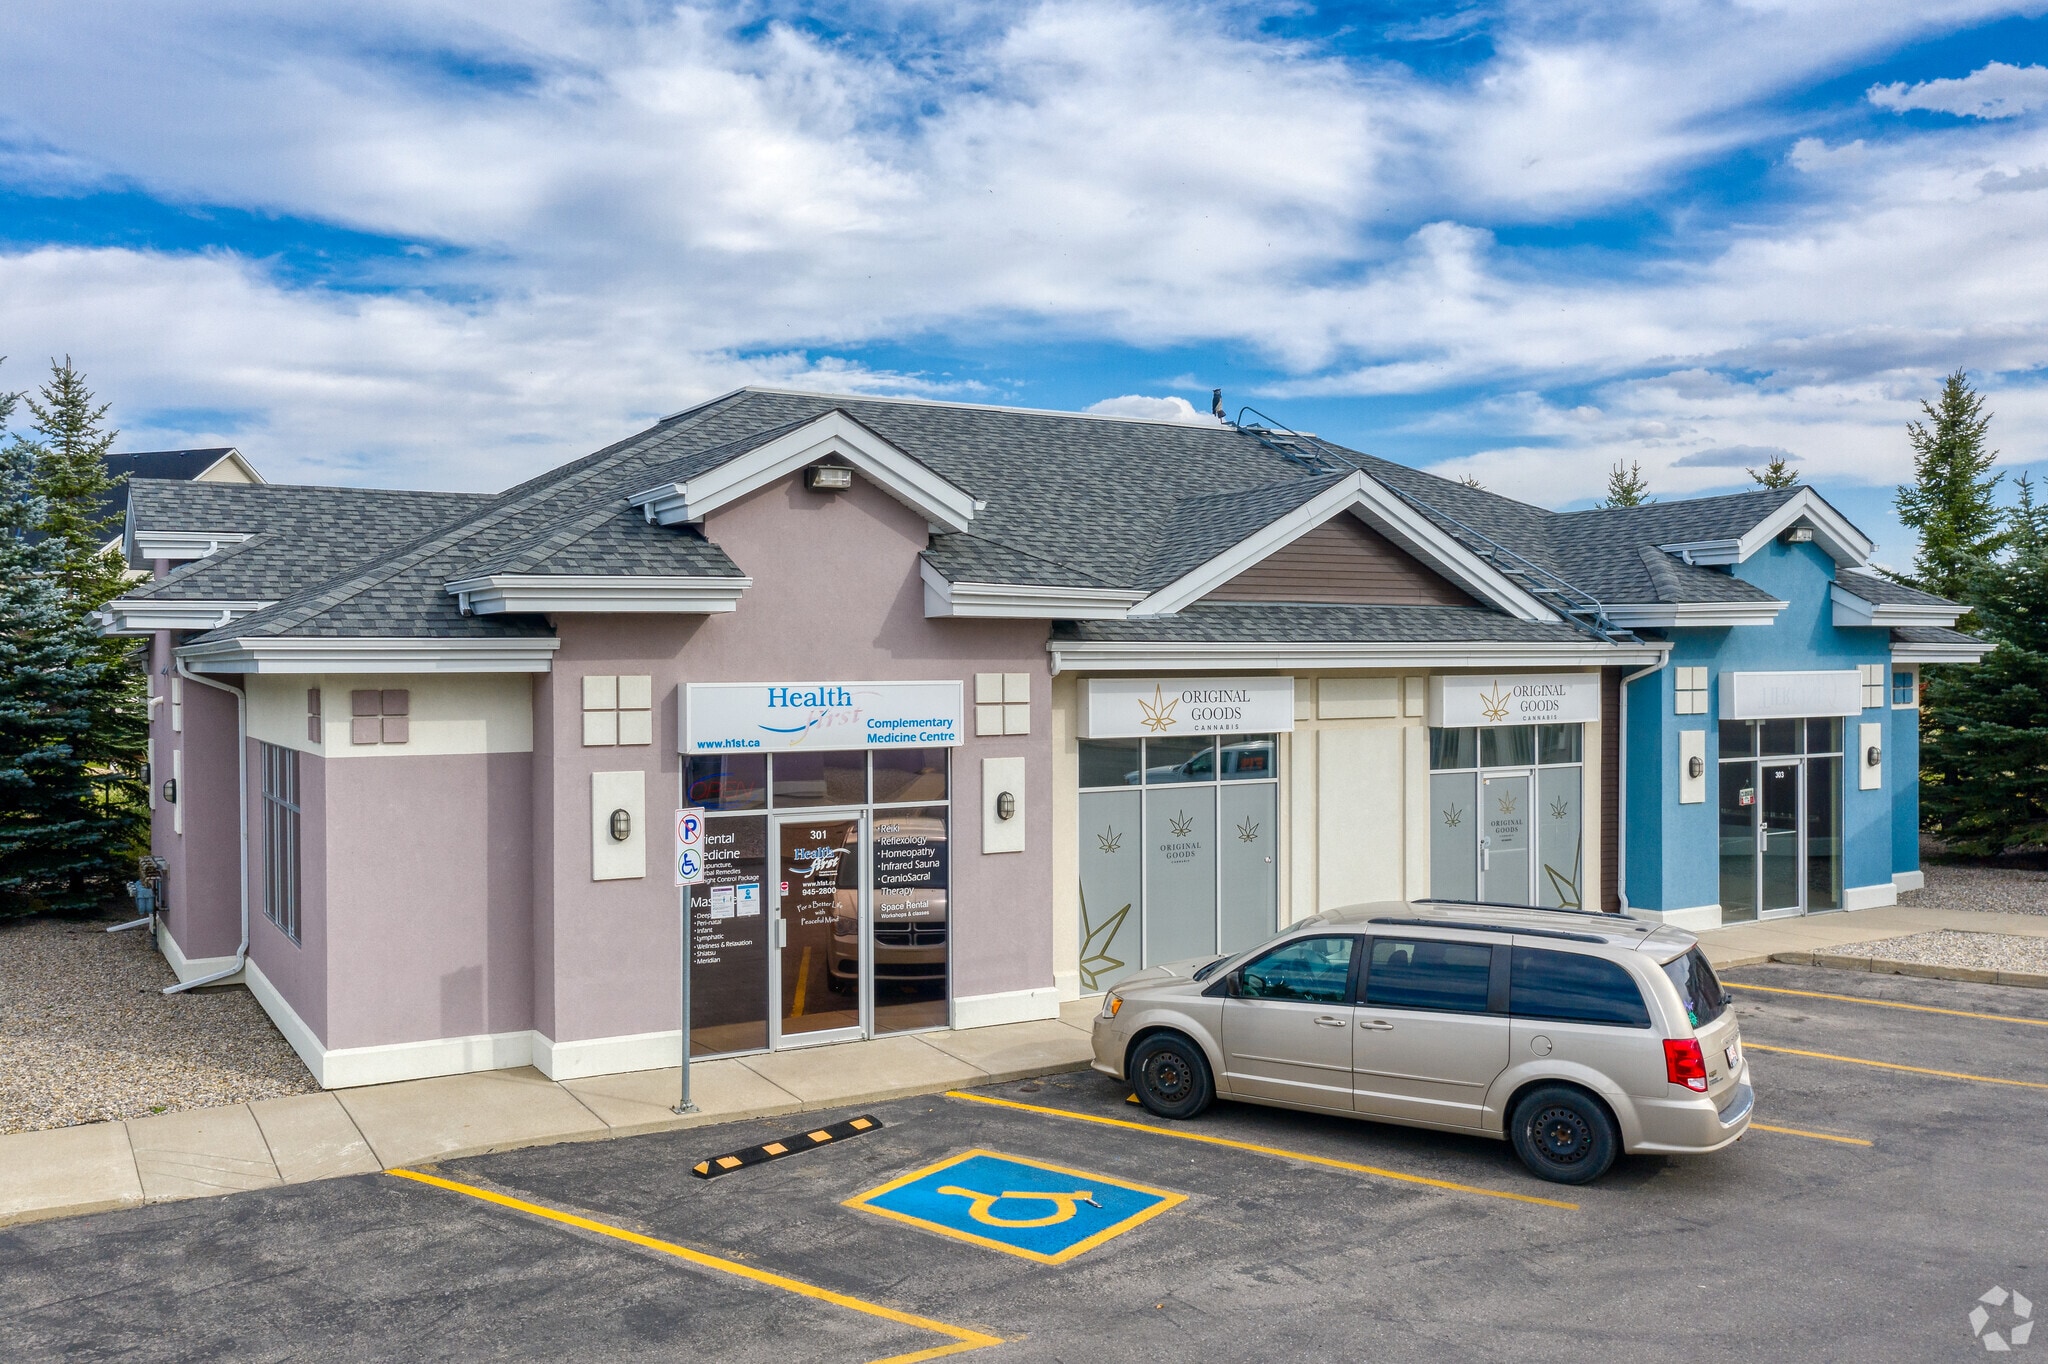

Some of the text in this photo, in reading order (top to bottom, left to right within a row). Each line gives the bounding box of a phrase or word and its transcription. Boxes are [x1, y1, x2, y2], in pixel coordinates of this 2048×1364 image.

[768, 686, 852, 707] Health
[1182, 690, 1250, 703] ORIGINAL
[1513, 685, 1566, 697] ORIGINAL
[1520, 700, 1559, 712] GOODS
[1191, 707, 1242, 720] GOODS
[867, 718, 953, 730] Complementary
[867, 731, 955, 743] Medicine Centre
[697, 738, 760, 749] www.h1st.ca
[689, 780, 755, 800] OPEN
[881, 824, 900, 832] Reiki
[1490, 819, 1523, 827] ORIGINAL
[684, 818, 698, 840] P
[810, 829, 827, 840] 301
[703, 833, 735, 845] iental
[881, 836, 927, 846] Reflexology
[1160, 842, 1201, 851] ORIGINAL
[704, 849, 741, 860] edicine
[794, 846, 835, 860] Health
[881, 847, 935, 858] Homeopathy
[1166, 850, 1196, 860] GOODS
[881, 860, 940, 870] Infrared Sauna
[717, 875, 738, 883] Control
[881, 872, 931, 883] CranioSacral
[802, 887, 837, 896] 945-2800
[881, 887, 915, 896] Therapy
[881, 900, 929, 912] Space Rental
